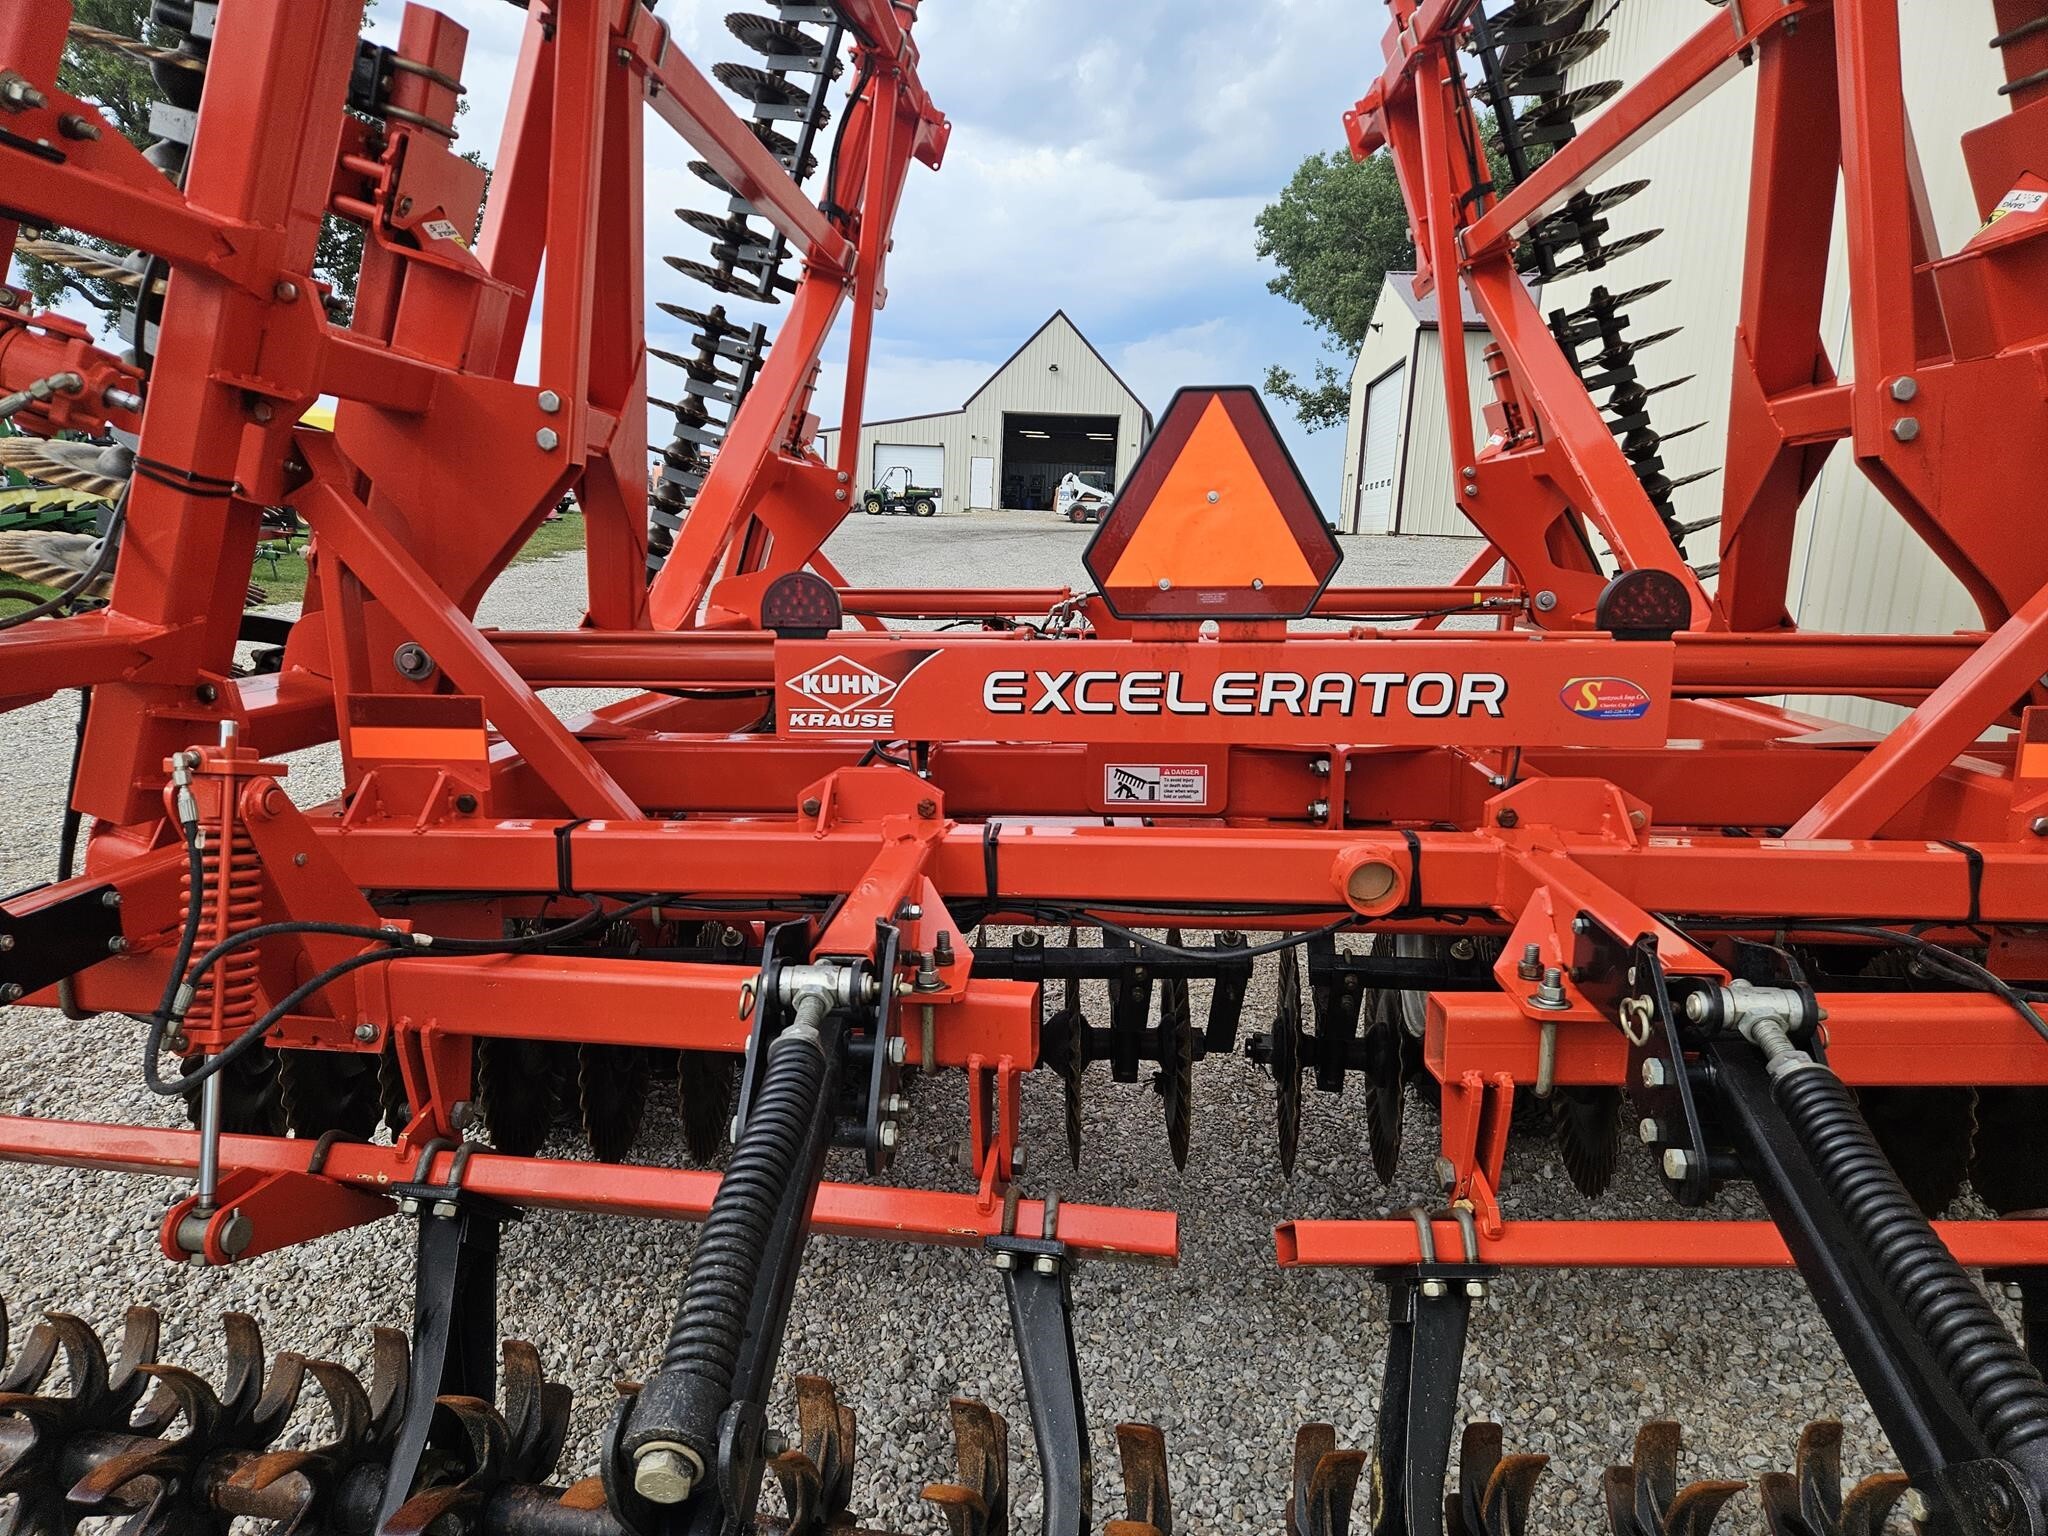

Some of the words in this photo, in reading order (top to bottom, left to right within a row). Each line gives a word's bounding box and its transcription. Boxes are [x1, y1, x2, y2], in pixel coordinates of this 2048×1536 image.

[2002, 201, 2025, 209] GANG
[802, 674, 880, 695] KUHN
[983, 671, 1509, 717] EXCELERATOR
[789, 713, 894, 728] KRAUSE
